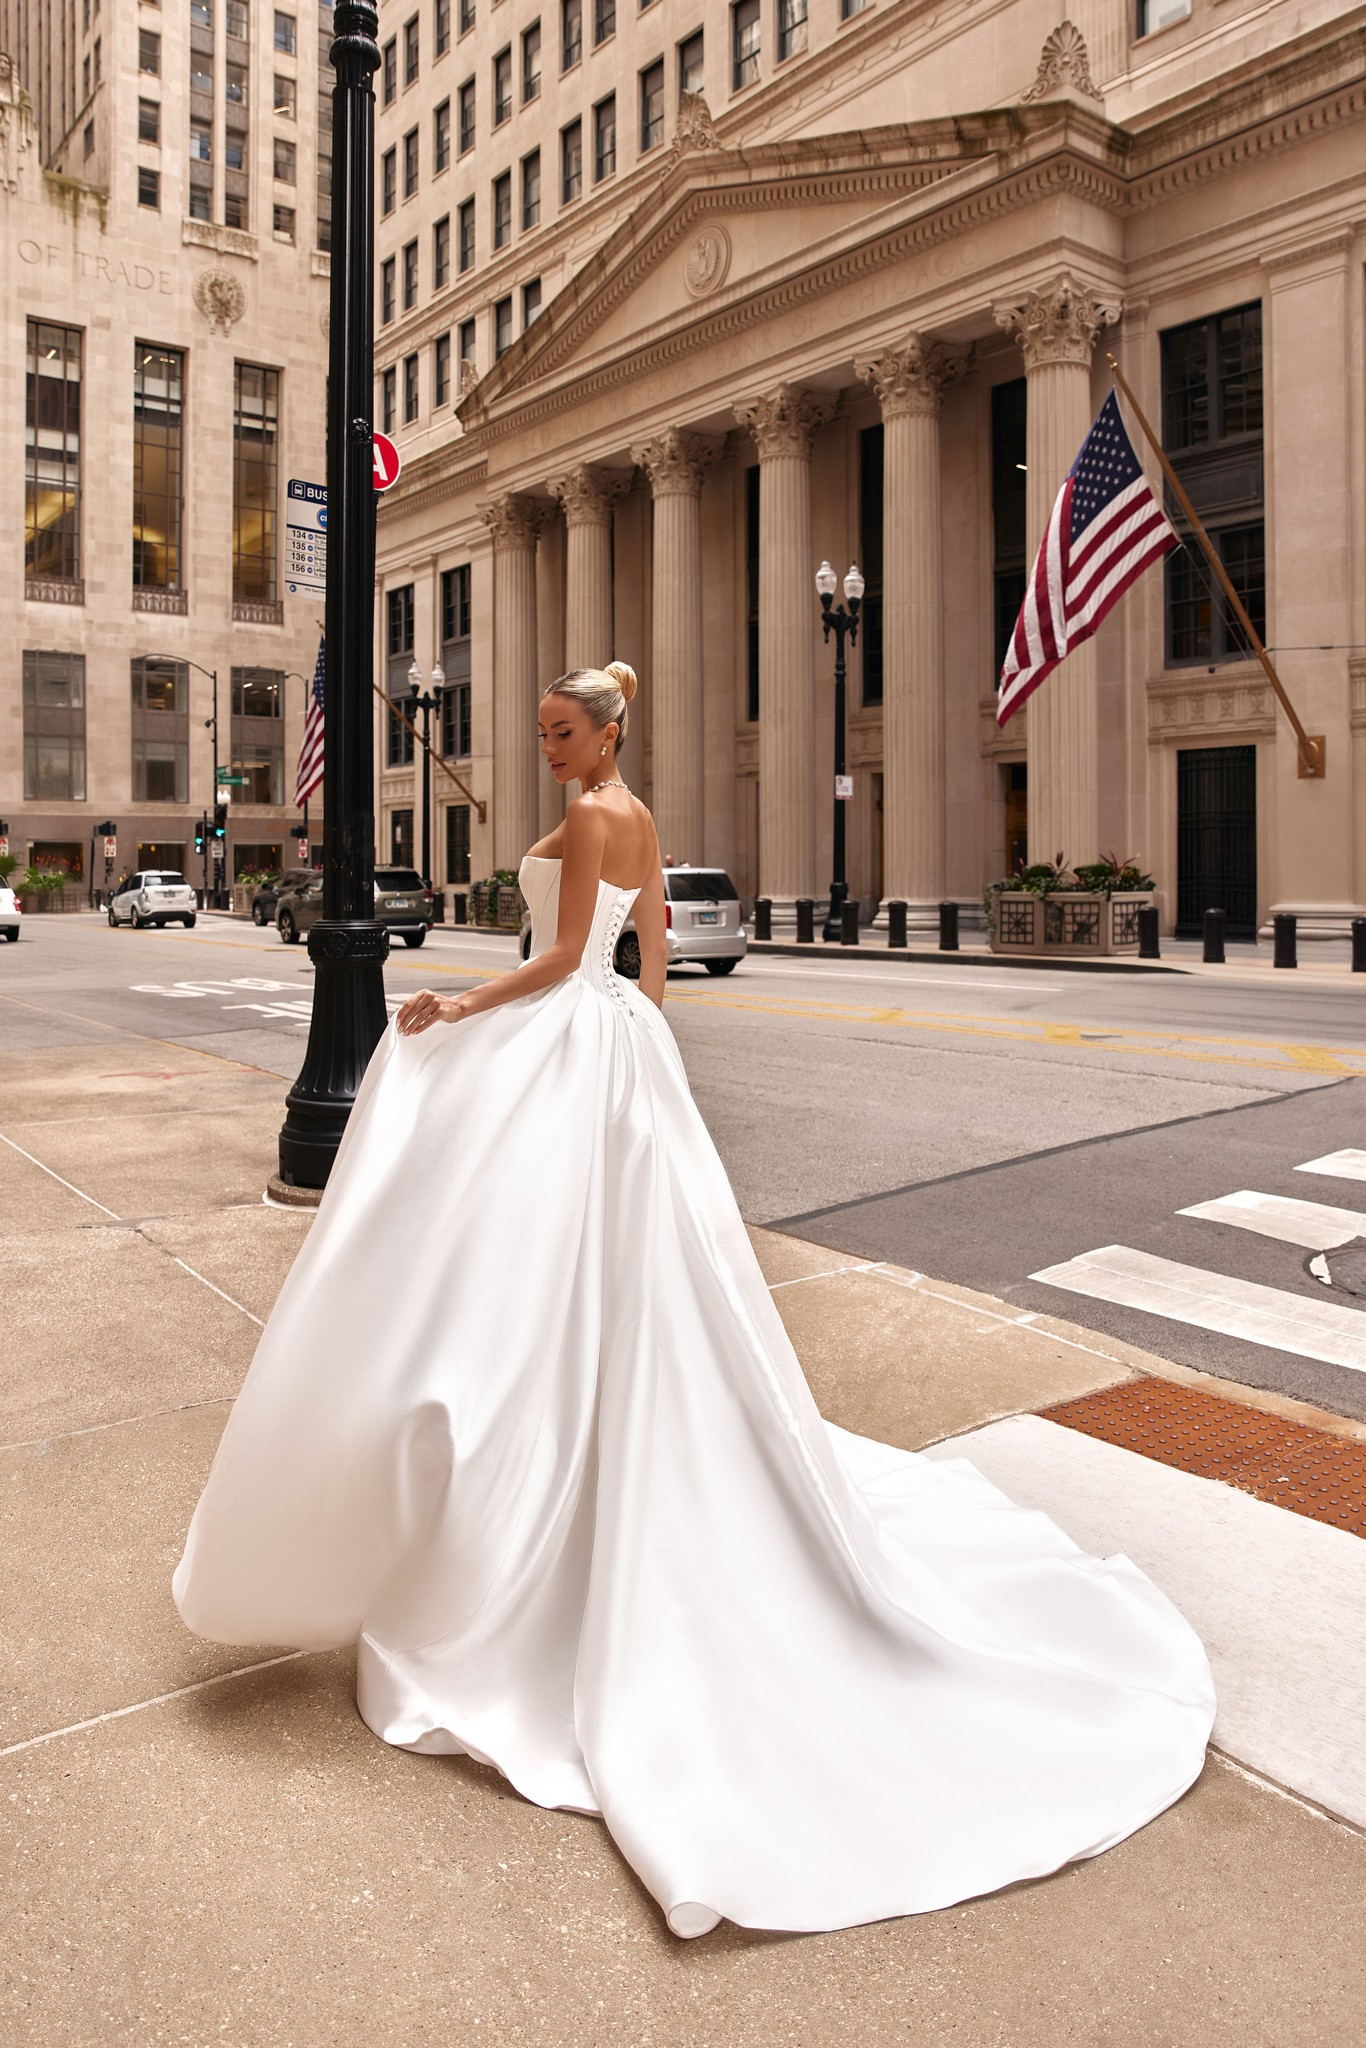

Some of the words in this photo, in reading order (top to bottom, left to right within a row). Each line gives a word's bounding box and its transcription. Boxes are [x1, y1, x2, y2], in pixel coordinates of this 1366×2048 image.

[17, 239, 60, 269] OF
[74, 250, 173, 296] TRADE
[609, 361, 697, 415] RESERVE
[715, 326, 773, 372] BANK
[790, 307, 818, 338] OF
[838, 240, 980, 318] CHICAGO
[373, 443, 389, 481] A
[307, 487, 328, 501] BUS
[292, 530, 306, 539] 134
[292, 541, 306, 550] 135
[291, 552, 306, 561] 136
[291, 563, 306, 573] 156
